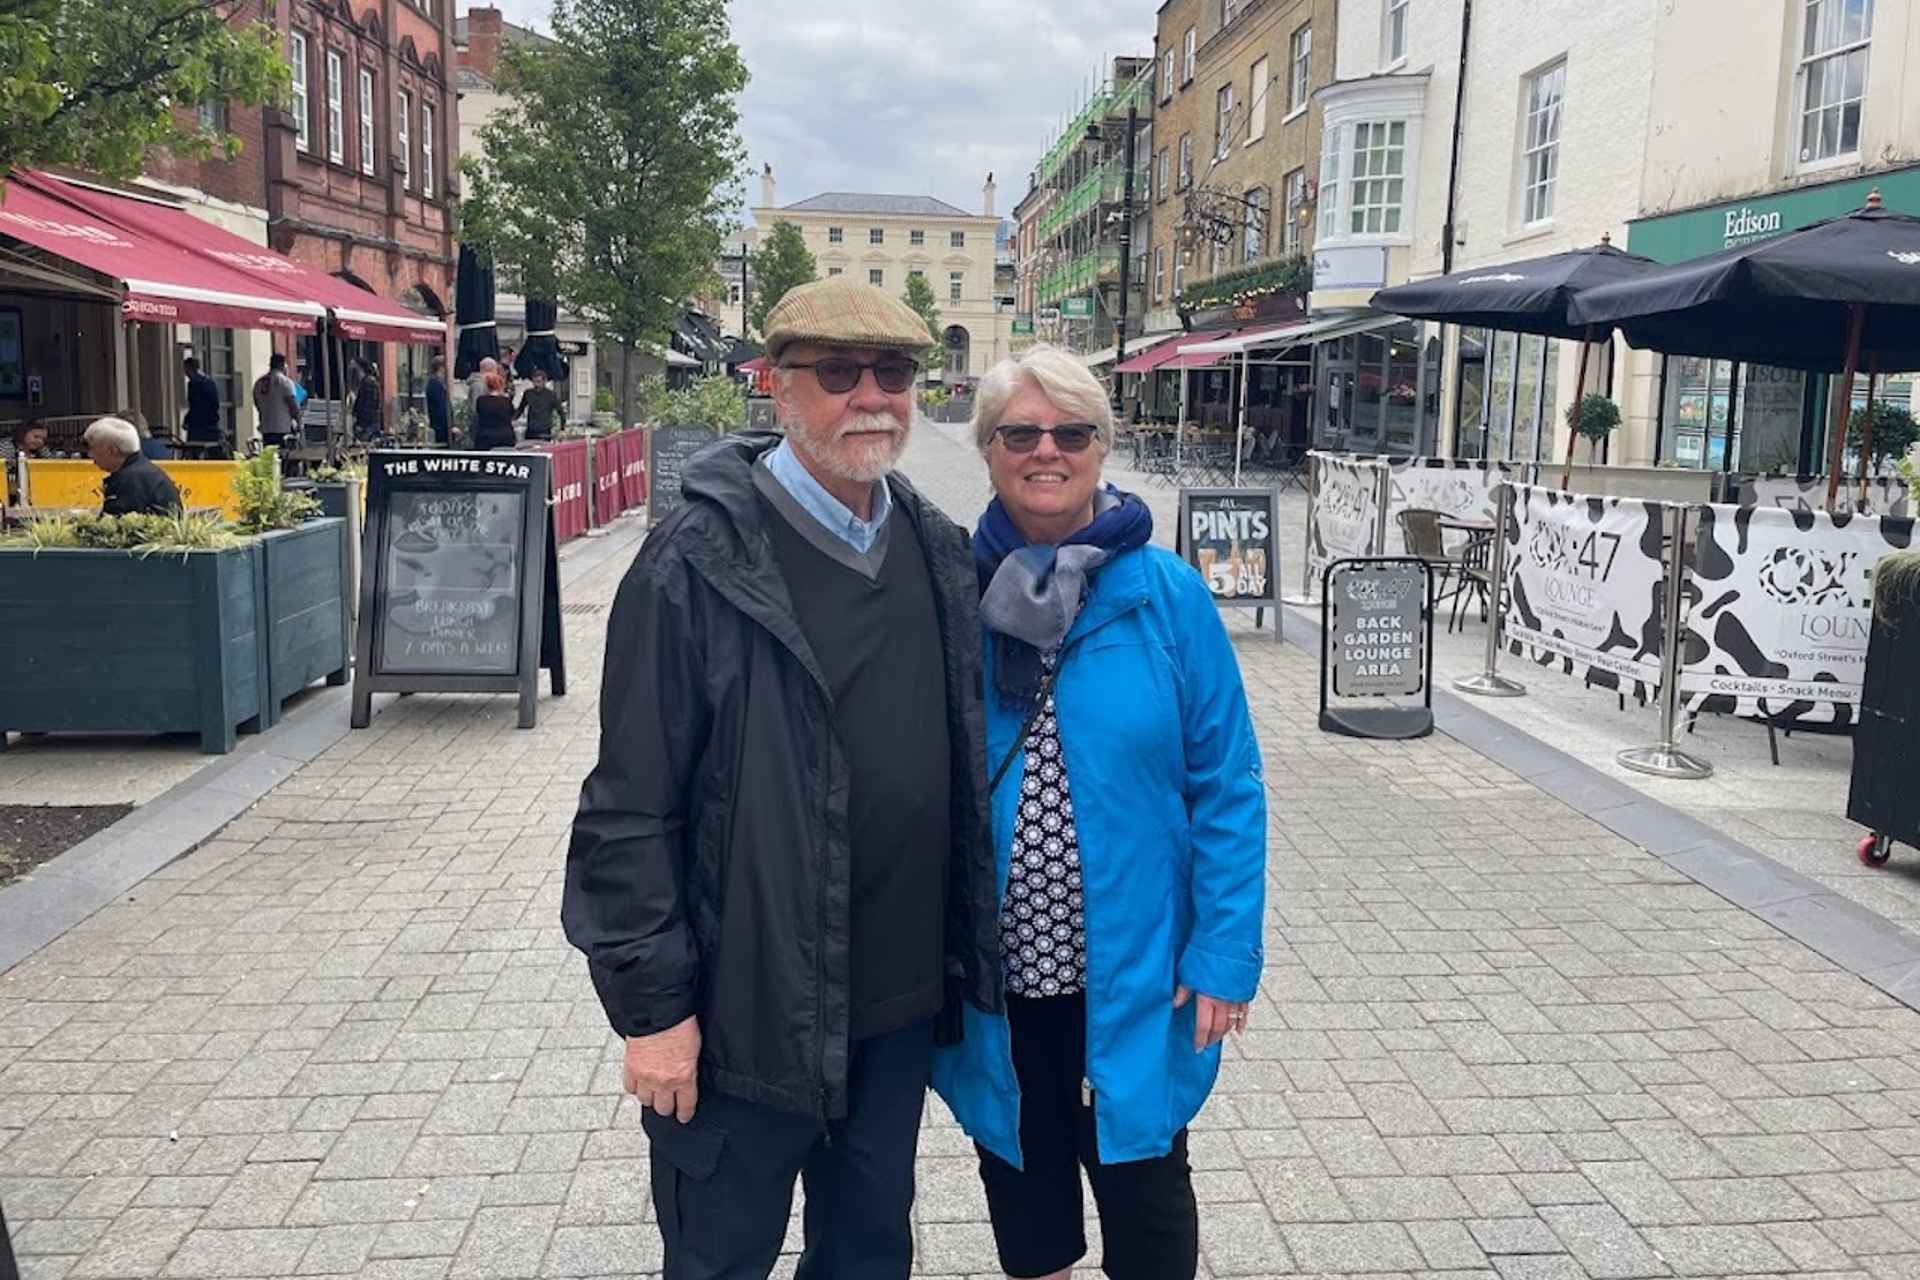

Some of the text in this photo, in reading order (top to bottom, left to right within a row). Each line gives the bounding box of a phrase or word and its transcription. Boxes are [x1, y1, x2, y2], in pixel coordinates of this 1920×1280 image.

[1723, 207, 1780, 237] Edison
[384, 458, 530, 479] THE WHITE STAR
[1191, 510, 1269, 541] PINTS
[1236, 578, 1267, 595] DAY
[1356, 615, 1402, 629] BACK
[1799, 614, 1870, 641] LOUN
[1343, 631, 1413, 645] GARDEN
[1344, 647, 1412, 661] LOUNGE
[1355, 662, 1401, 676] AREA
[1710, 679, 1851, 699] Cocktails Snack Menu
